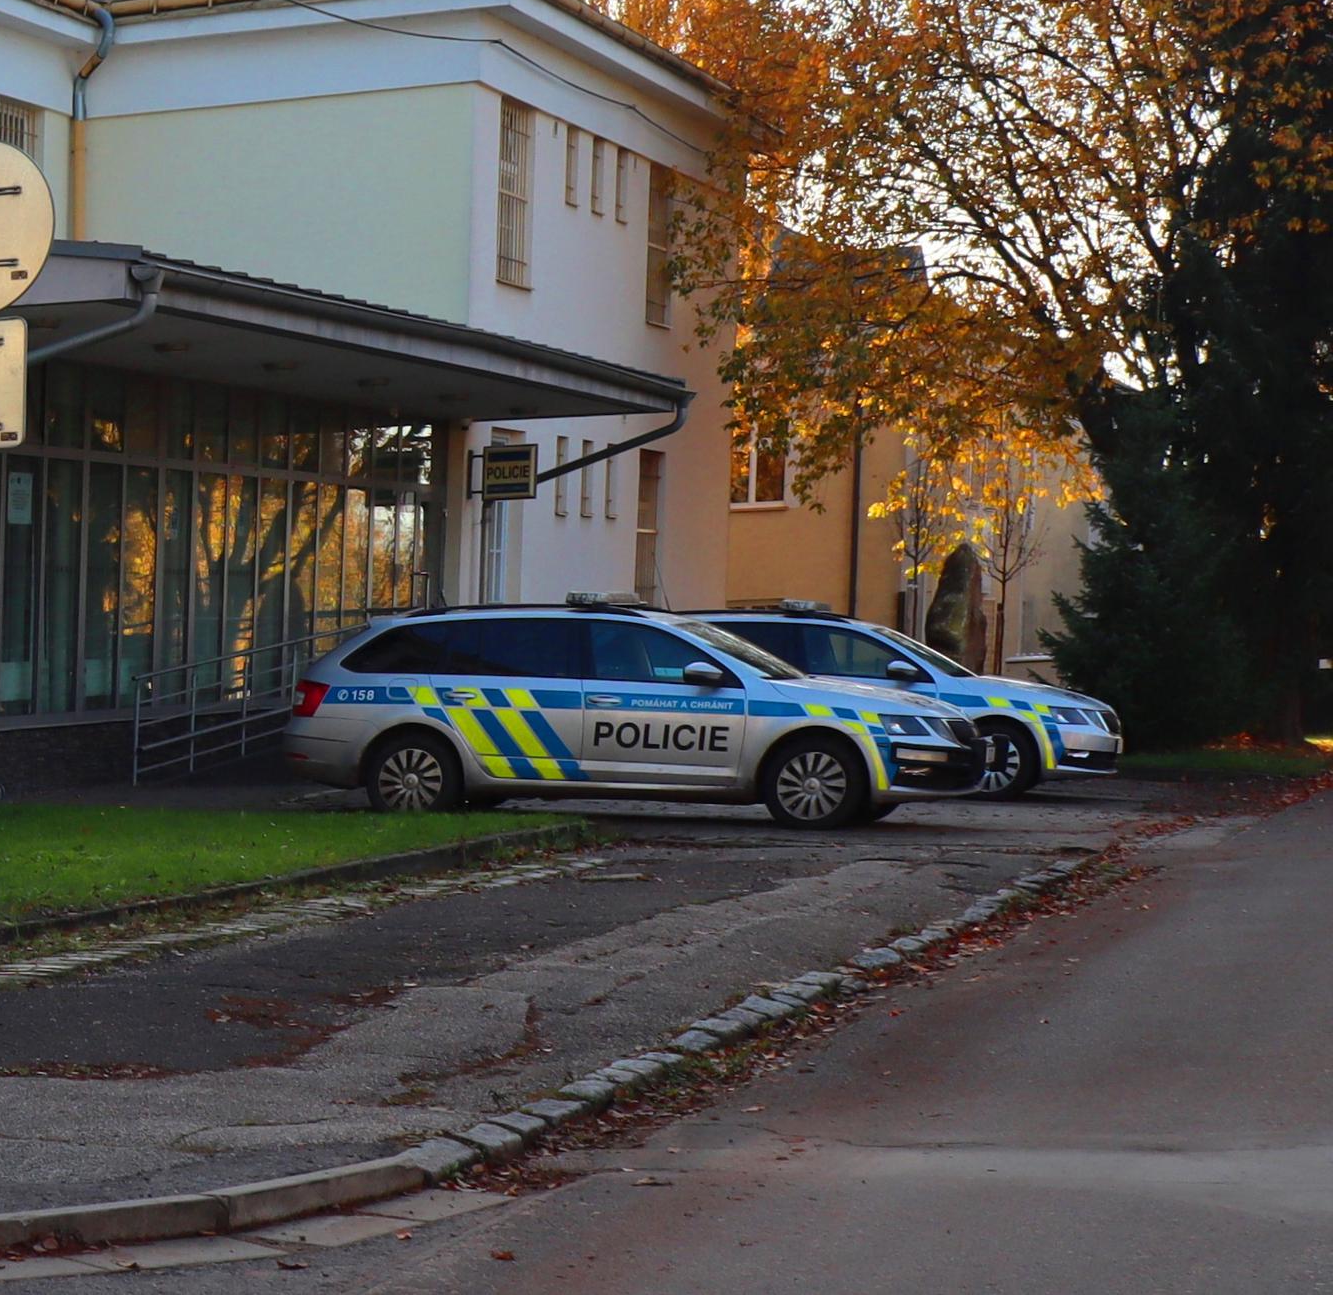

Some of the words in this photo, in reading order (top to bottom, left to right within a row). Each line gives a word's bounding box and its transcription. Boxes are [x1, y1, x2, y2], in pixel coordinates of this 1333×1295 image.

[486, 464, 530, 480] POLICIE
[351, 689, 374, 701] 158
[631, 697, 678, 709] POMÁHAT
[680, 699, 688, 709] A
[690, 698, 734, 710] CHRÁNIT
[593, 721, 730, 752] POLICIE
